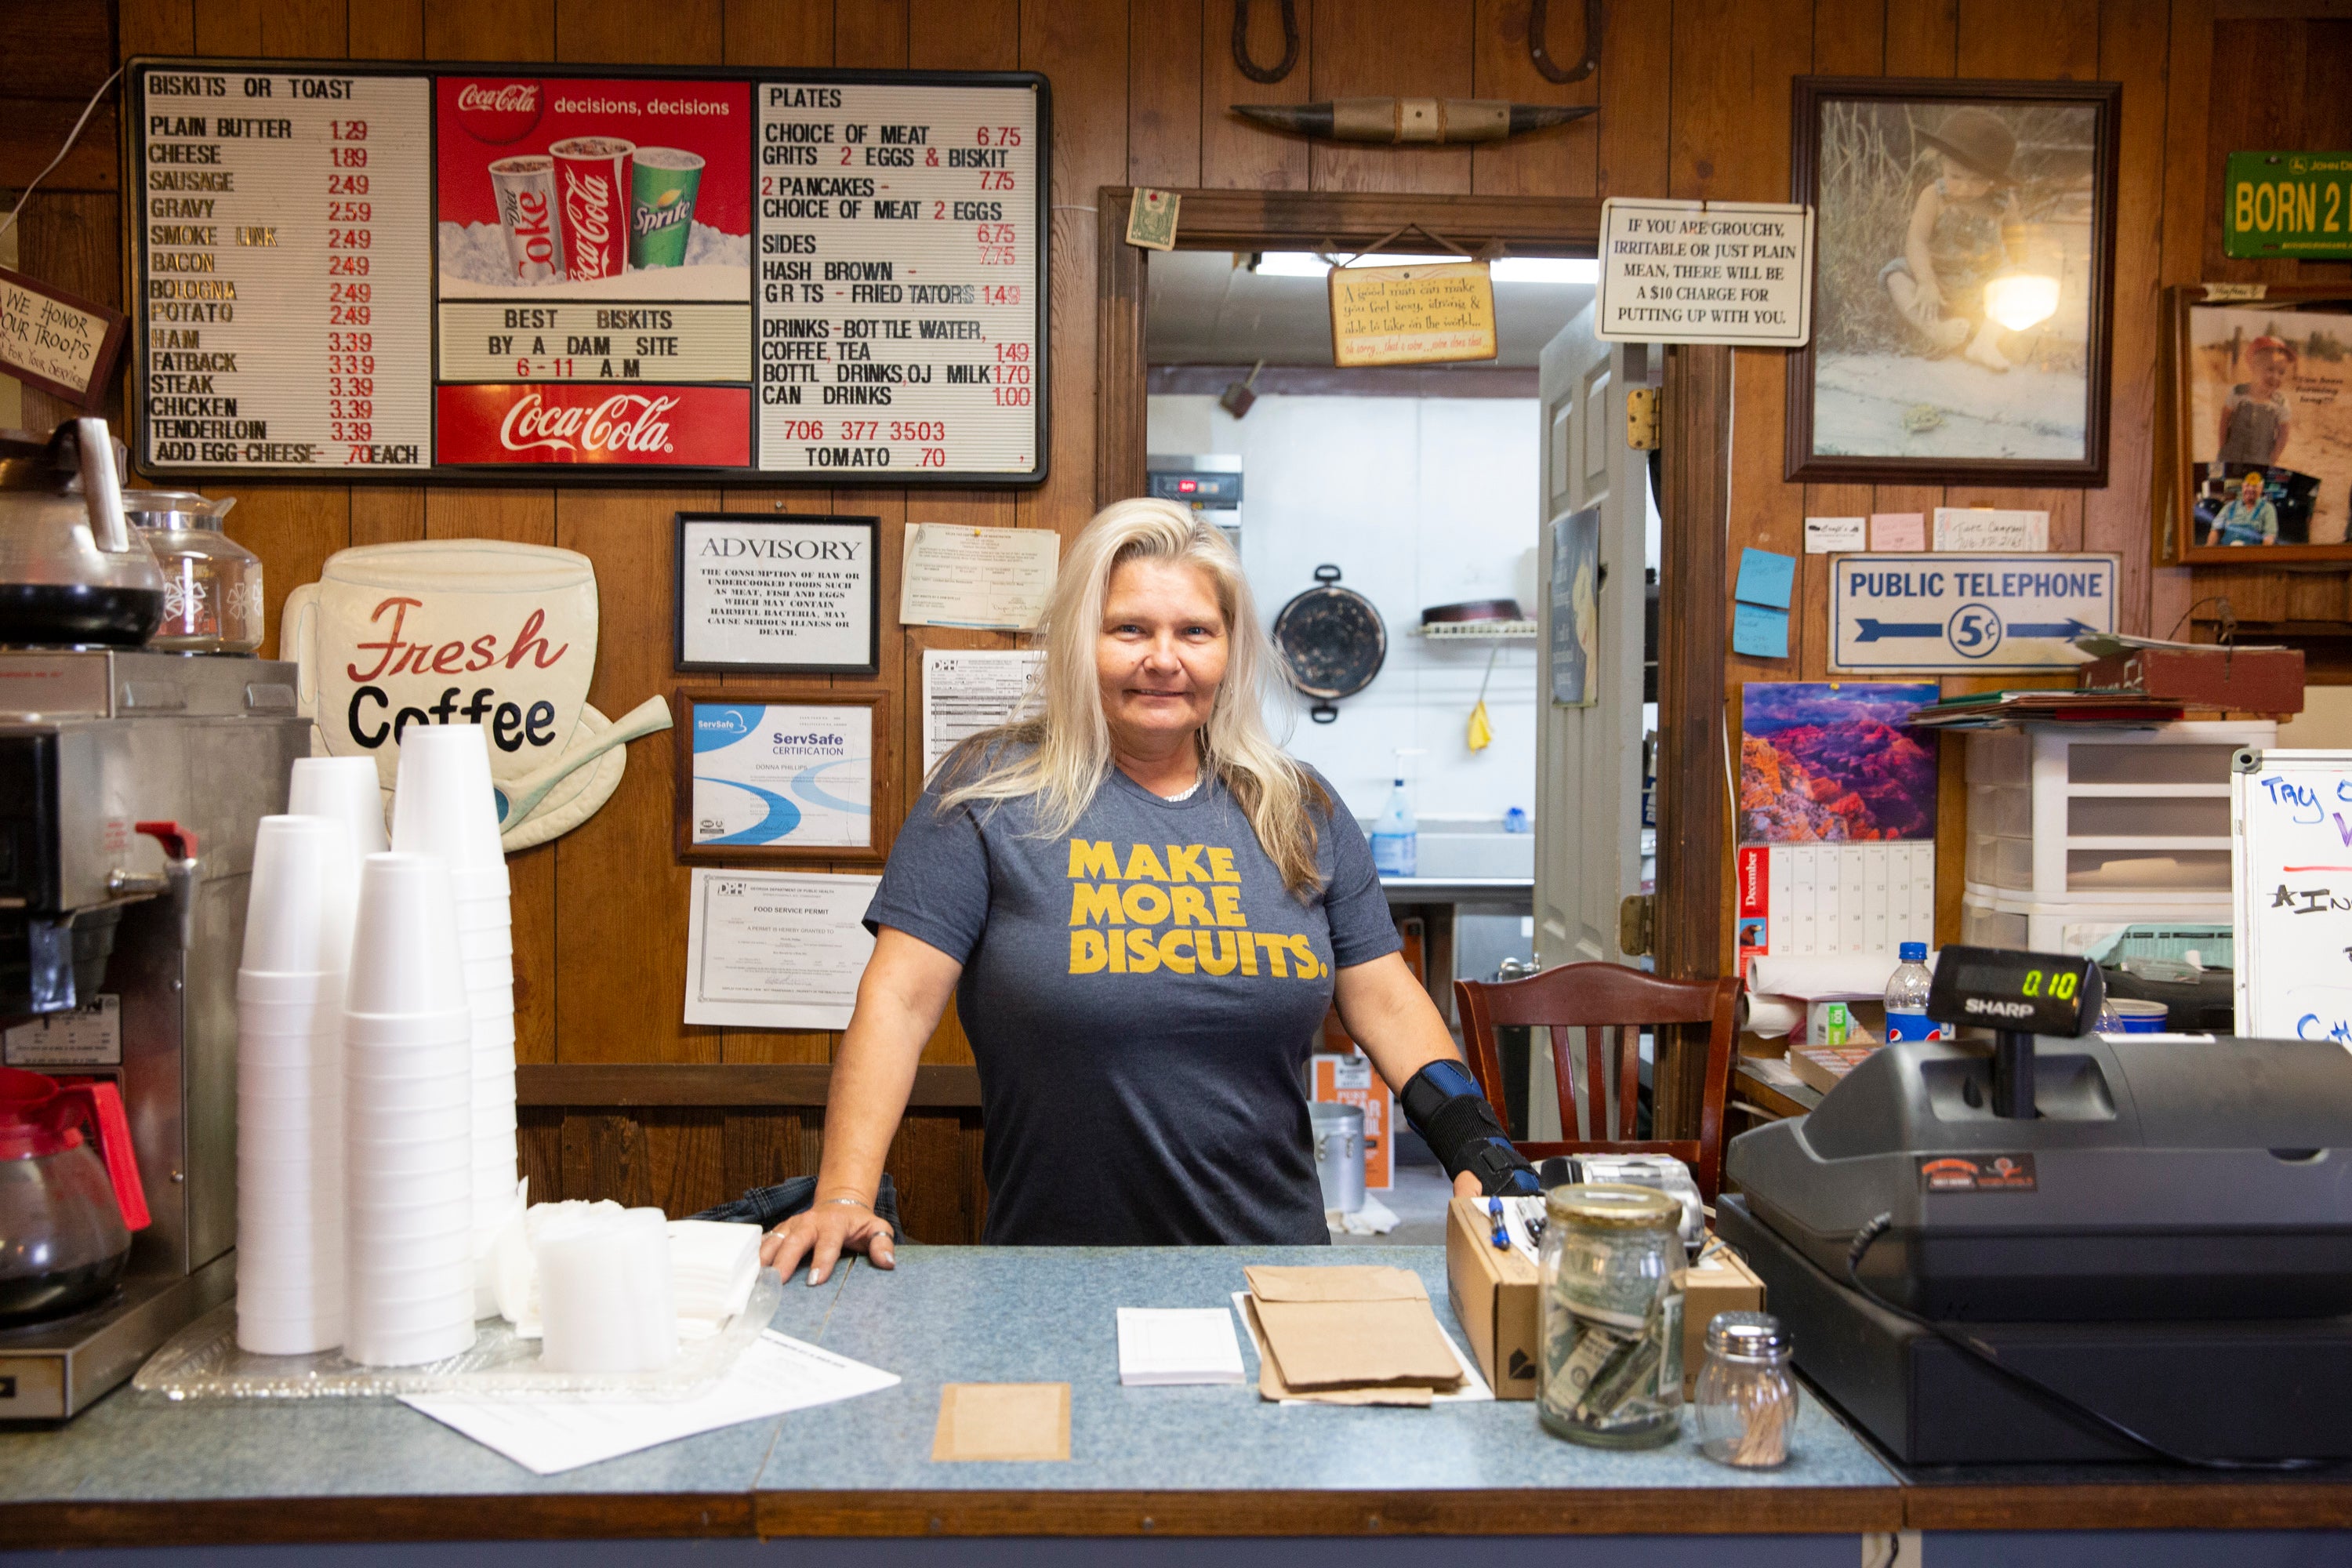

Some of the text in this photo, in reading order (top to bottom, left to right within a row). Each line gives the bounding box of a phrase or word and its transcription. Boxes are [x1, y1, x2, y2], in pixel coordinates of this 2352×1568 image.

[149, 76, 354, 100] BISKITS OR TOAST
[770, 88, 841, 108] PLATES
[554, 97, 729, 116] decisions, decisions
[150, 117, 368, 140] PLAIN BUTTER 1.29
[766, 124, 1021, 147] CHOICE OF MEAT 6.75
[148, 144, 221, 164] CHEESE
[763, 146, 1008, 168] GRITS 2 EGGS & BISKIT
[149, 172, 368, 195] SAUSAGE 2.49
[762, 177, 874, 197] 2 PANCAKES
[980, 171, 1014, 191] 7.75
[151, 199, 371, 222] GRAVY 2.59
[633, 197, 691, 235] Sprite
[763, 199, 1002, 220] CHOICE OF MEAT 2 EGGS
[2236, 182, 2340, 232] BORN 2
[977, 223, 1015, 245] 6.75
[1628, 219, 1642, 231] IF
[1646, 220, 1677, 233] YOU
[1679, 221, 1708, 234] ARE
[151, 226, 371, 249] SMOKE 2.49
[763, 234, 816, 254] SIDES
[979, 246, 1015, 265] 7.75
[1614, 241, 1796, 259] IRRITABLE OR JUST PLAIN
[151, 252, 370, 276] BACON 2.49
[763, 261, 892, 281] HASH BROWN
[1674, 265, 1722, 279] THERE
[1726, 267, 1762, 280] WILL
[1766, 267, 1784, 280] BE
[330, 283, 371, 303] 2.49
[852, 285, 1019, 306] FRIED TATORS 1.49
[1636, 286, 1769, 301] A $10 CHARGE FOR
[6, 289, 89, 338] WE HONOR
[151, 303, 371, 325] POTATO 2.49
[505, 309, 673, 329] BEST BISKITS
[1618, 307, 1786, 324] PUTTING UP WITH YOU.
[2, 313, 29, 342] OUR
[34, 322, 92, 360] TROOPS
[151, 329, 372, 352] HAM 3.39
[488, 336, 678, 356] BY A DAM SITE
[151, 353, 237, 372] FATBACK
[837, 342, 1029, 364] TEA 1.49
[947, 365, 990, 383] MILK
[993, 365, 1030, 385] 1.70
[151, 375, 373, 397] STEAK 3.39
[763, 387, 1030, 407] CAN DRINKS 1.00
[151, 397, 372, 419] CHICKEN 3.39
[151, 420, 372, 441] TENDERLOIN 3.39
[785, 421, 945, 441] 706 377 3503
[157, 442, 195, 462] ADD
[805, 448, 890, 466] TOMATO
[699, 537, 862, 561] ADVISORY
[1850, 572, 2103, 597] PUBLIC TELEPHONE
[347, 597, 569, 683] Fresh
[699, 720, 734, 729] ServSafe
[773, 733, 844, 745] ServSafe
[773, 746, 844, 756] CERTIFICATION
[1067, 838, 1242, 884] MAKE
[1745, 851, 1757, 906] December
[1069, 882, 1247, 927] MORE
[1965, 998, 2034, 1018] SHARP
